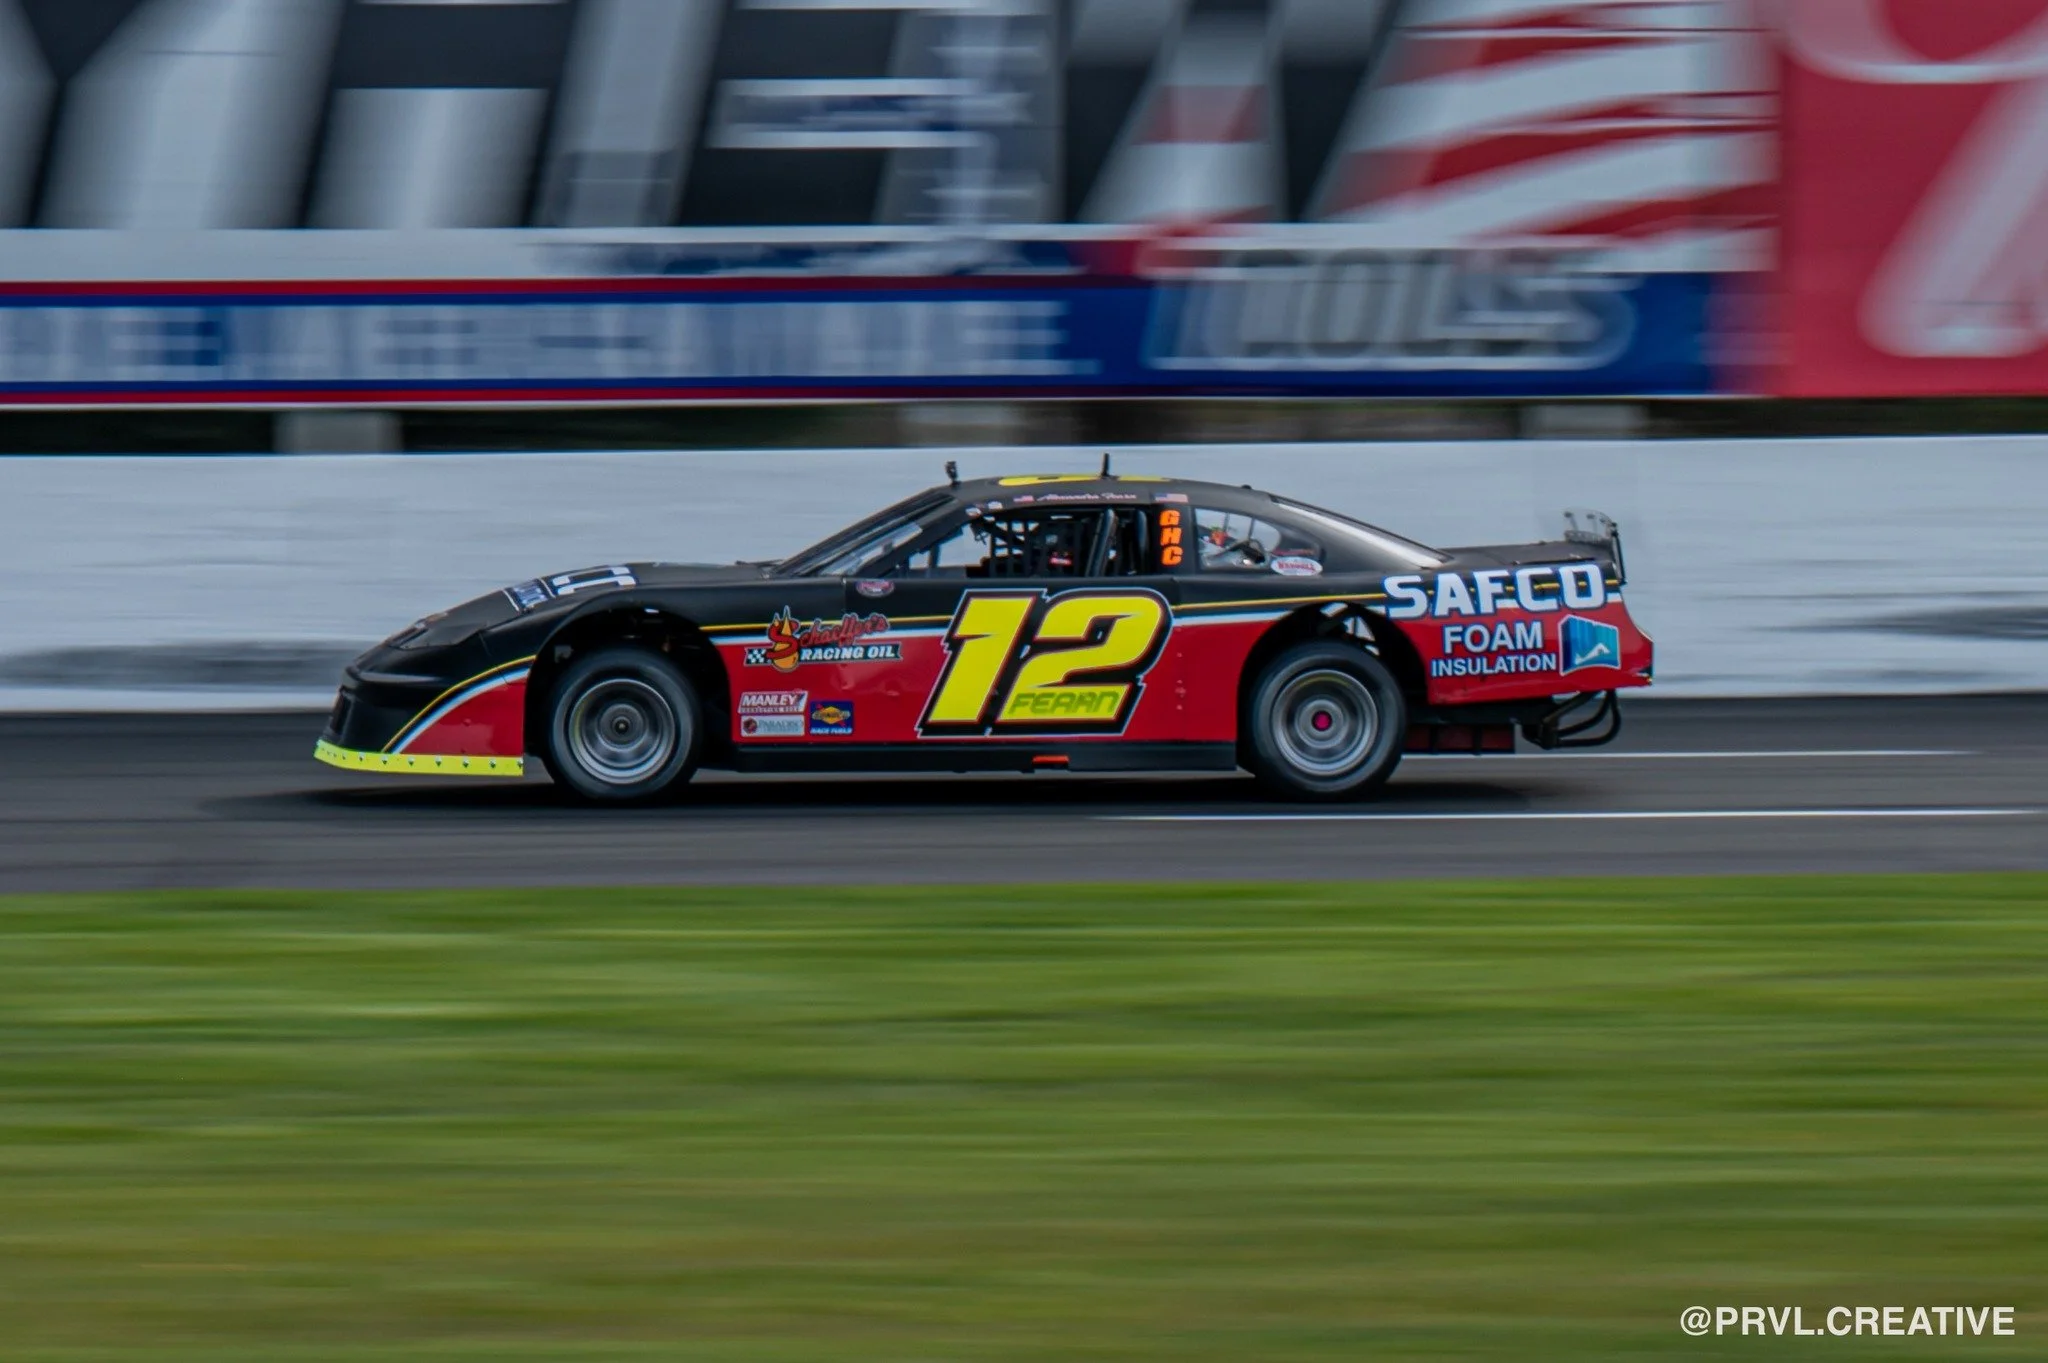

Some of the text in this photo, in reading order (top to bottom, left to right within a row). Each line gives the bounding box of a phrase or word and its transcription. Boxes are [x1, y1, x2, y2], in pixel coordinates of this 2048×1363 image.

[1383, 563, 1605, 619] SAFCO
[1444, 621, 1544, 654] FOAM
[801, 645, 896, 661] RACING OIL
[925, 590, 1166, 735] 12
[1431, 654, 1556, 677] INSULATION
[742, 694, 797, 706] MANLEY
[1008, 691, 1119, 714] FEARN
